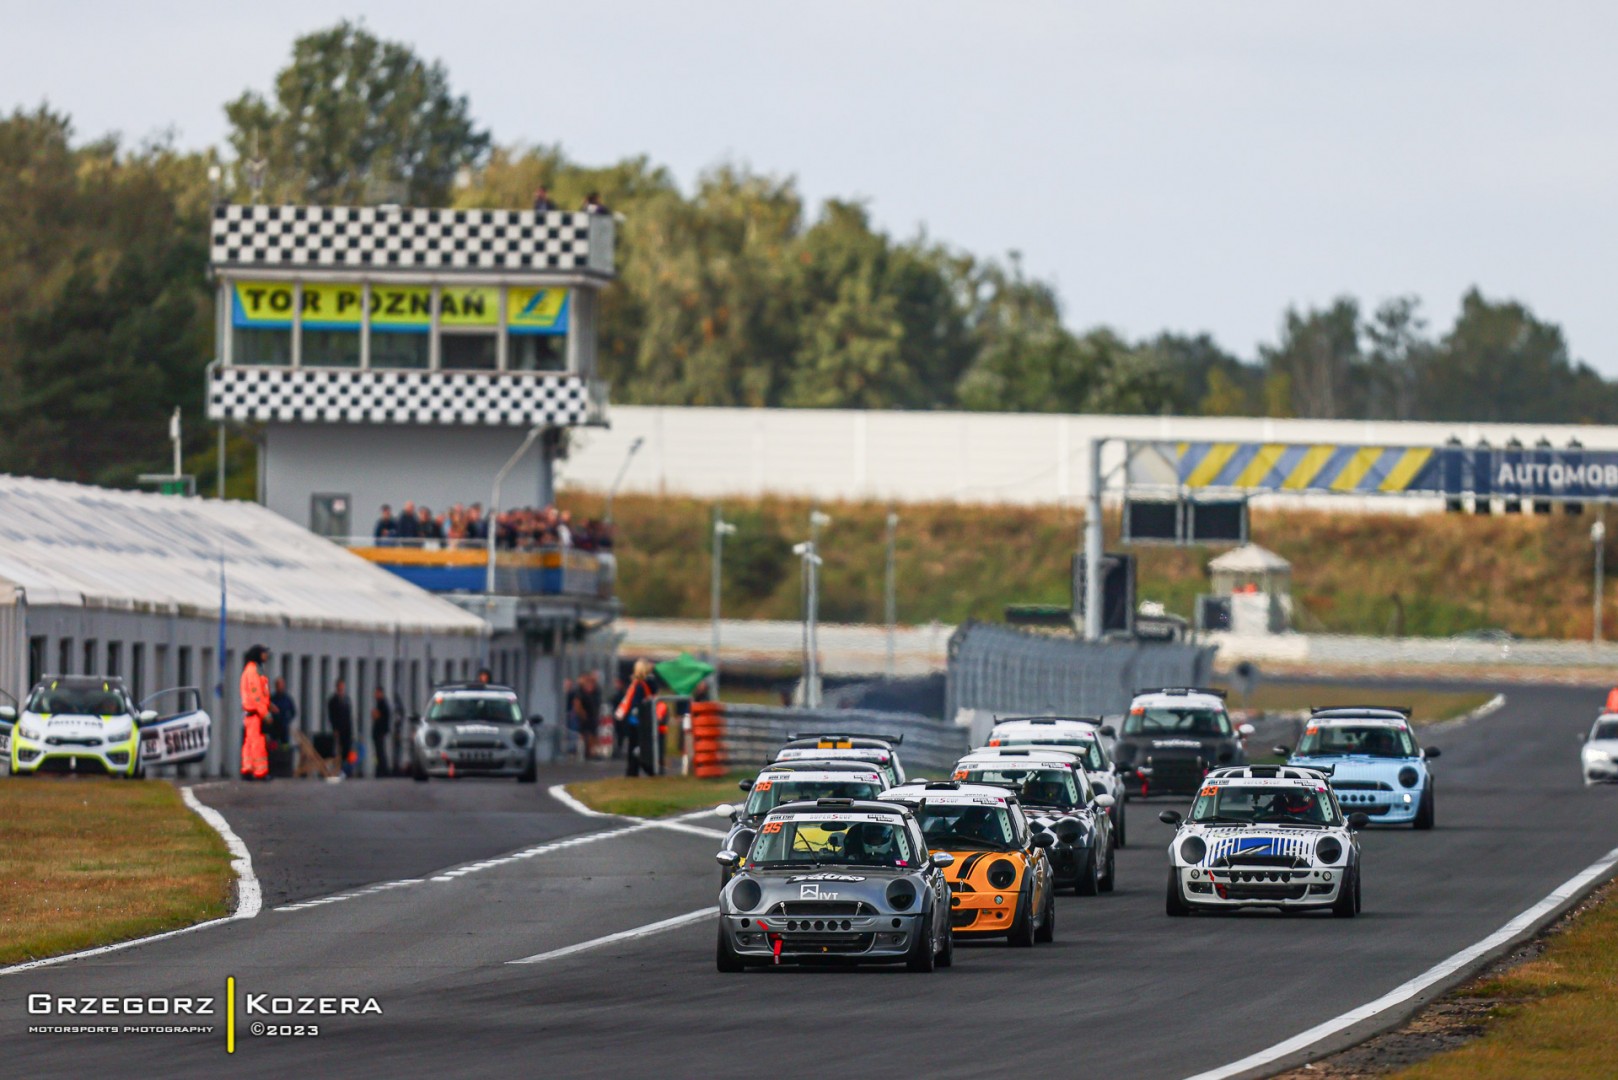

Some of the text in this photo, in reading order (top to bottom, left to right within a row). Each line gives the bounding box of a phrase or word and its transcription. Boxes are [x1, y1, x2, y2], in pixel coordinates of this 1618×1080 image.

[246, 288, 486, 316] TOR POZNAŃ
[755, 780, 773, 792] 66
[1201, 785, 1219, 797] 83
[761, 822, 784, 834] 95
[819, 892, 839, 900] IVT
